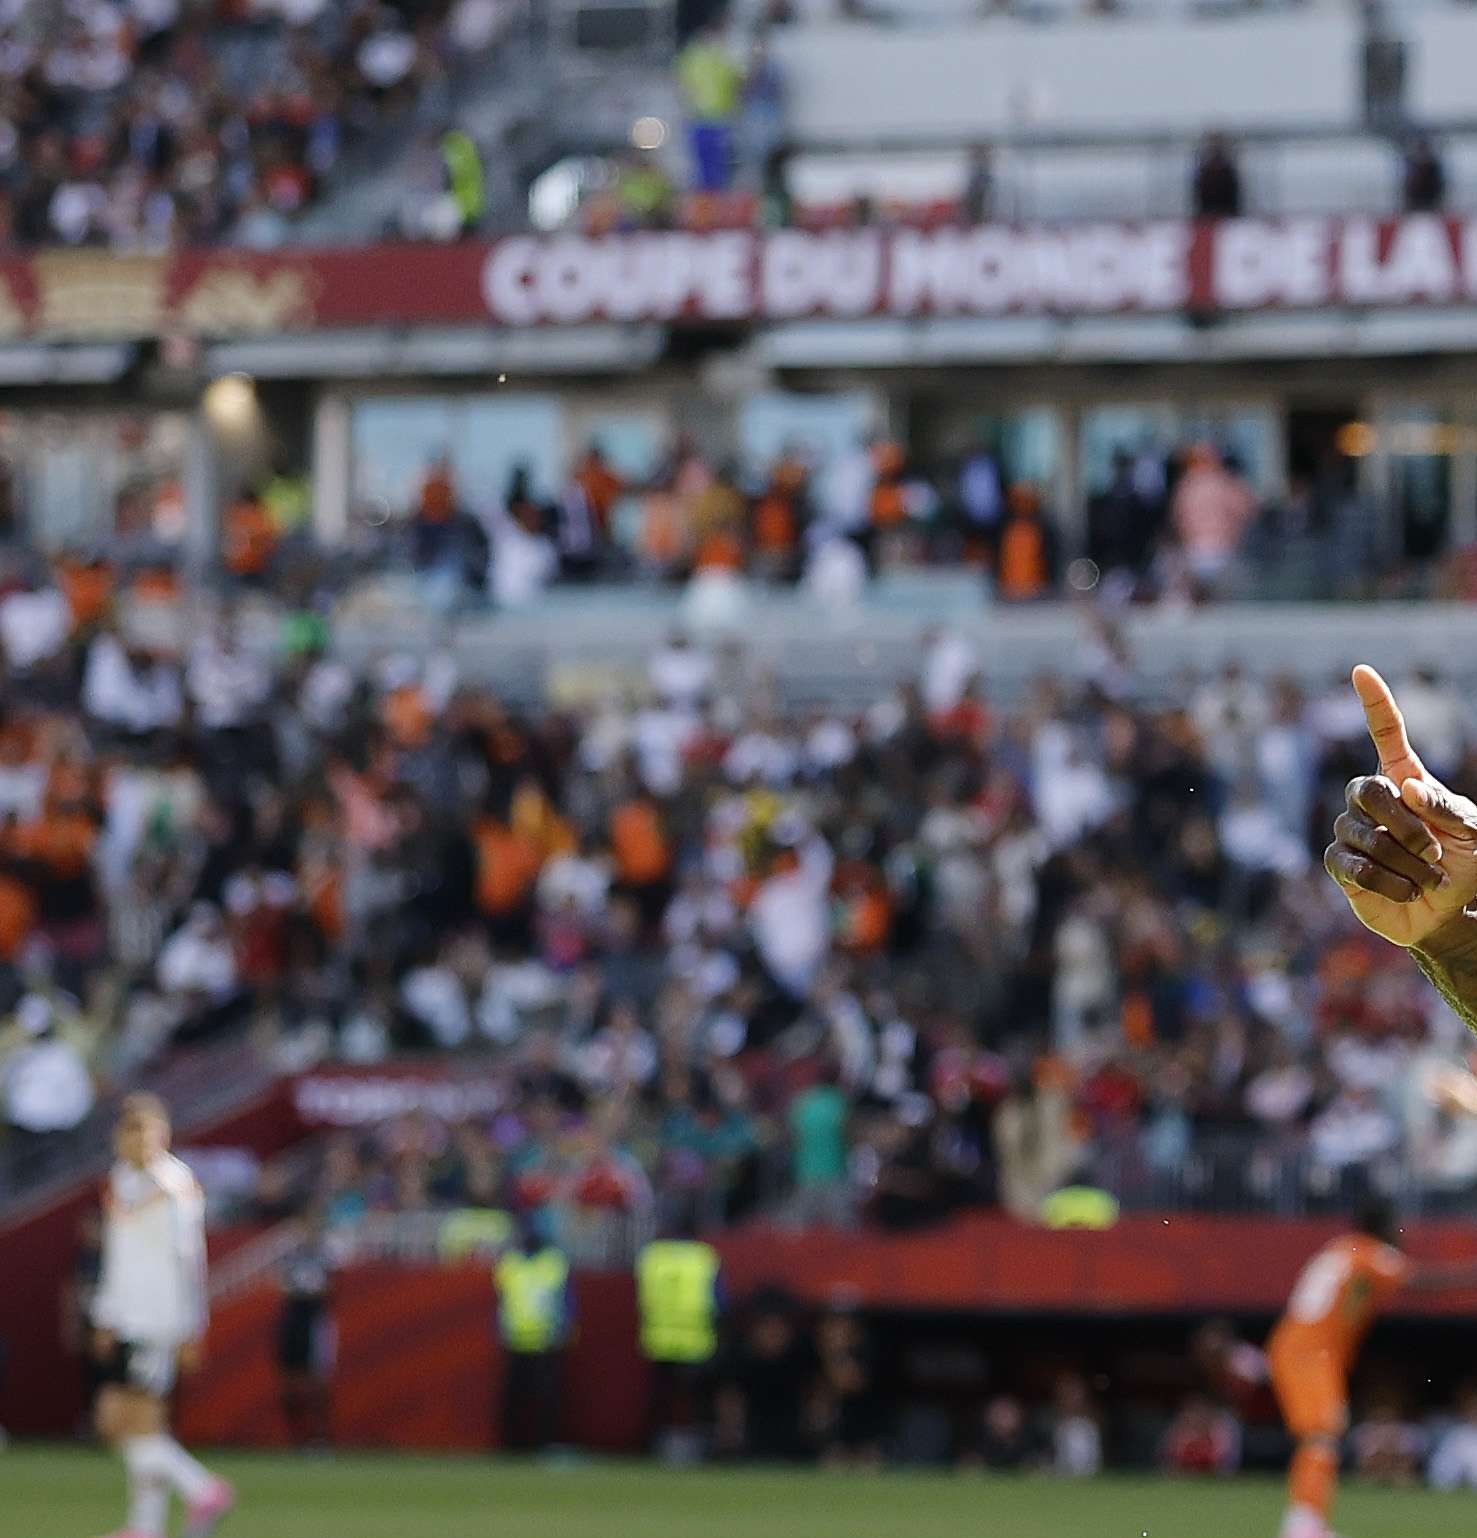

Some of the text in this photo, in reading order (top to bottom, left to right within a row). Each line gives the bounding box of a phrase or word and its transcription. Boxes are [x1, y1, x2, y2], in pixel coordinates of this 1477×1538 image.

[484, 231, 753, 322] COUPE
[761, 231, 880, 317] DU
[888, 225, 1188, 311] MONDE
[1213, 212, 1325, 308] DE
[1334, 208, 1457, 306] LA
